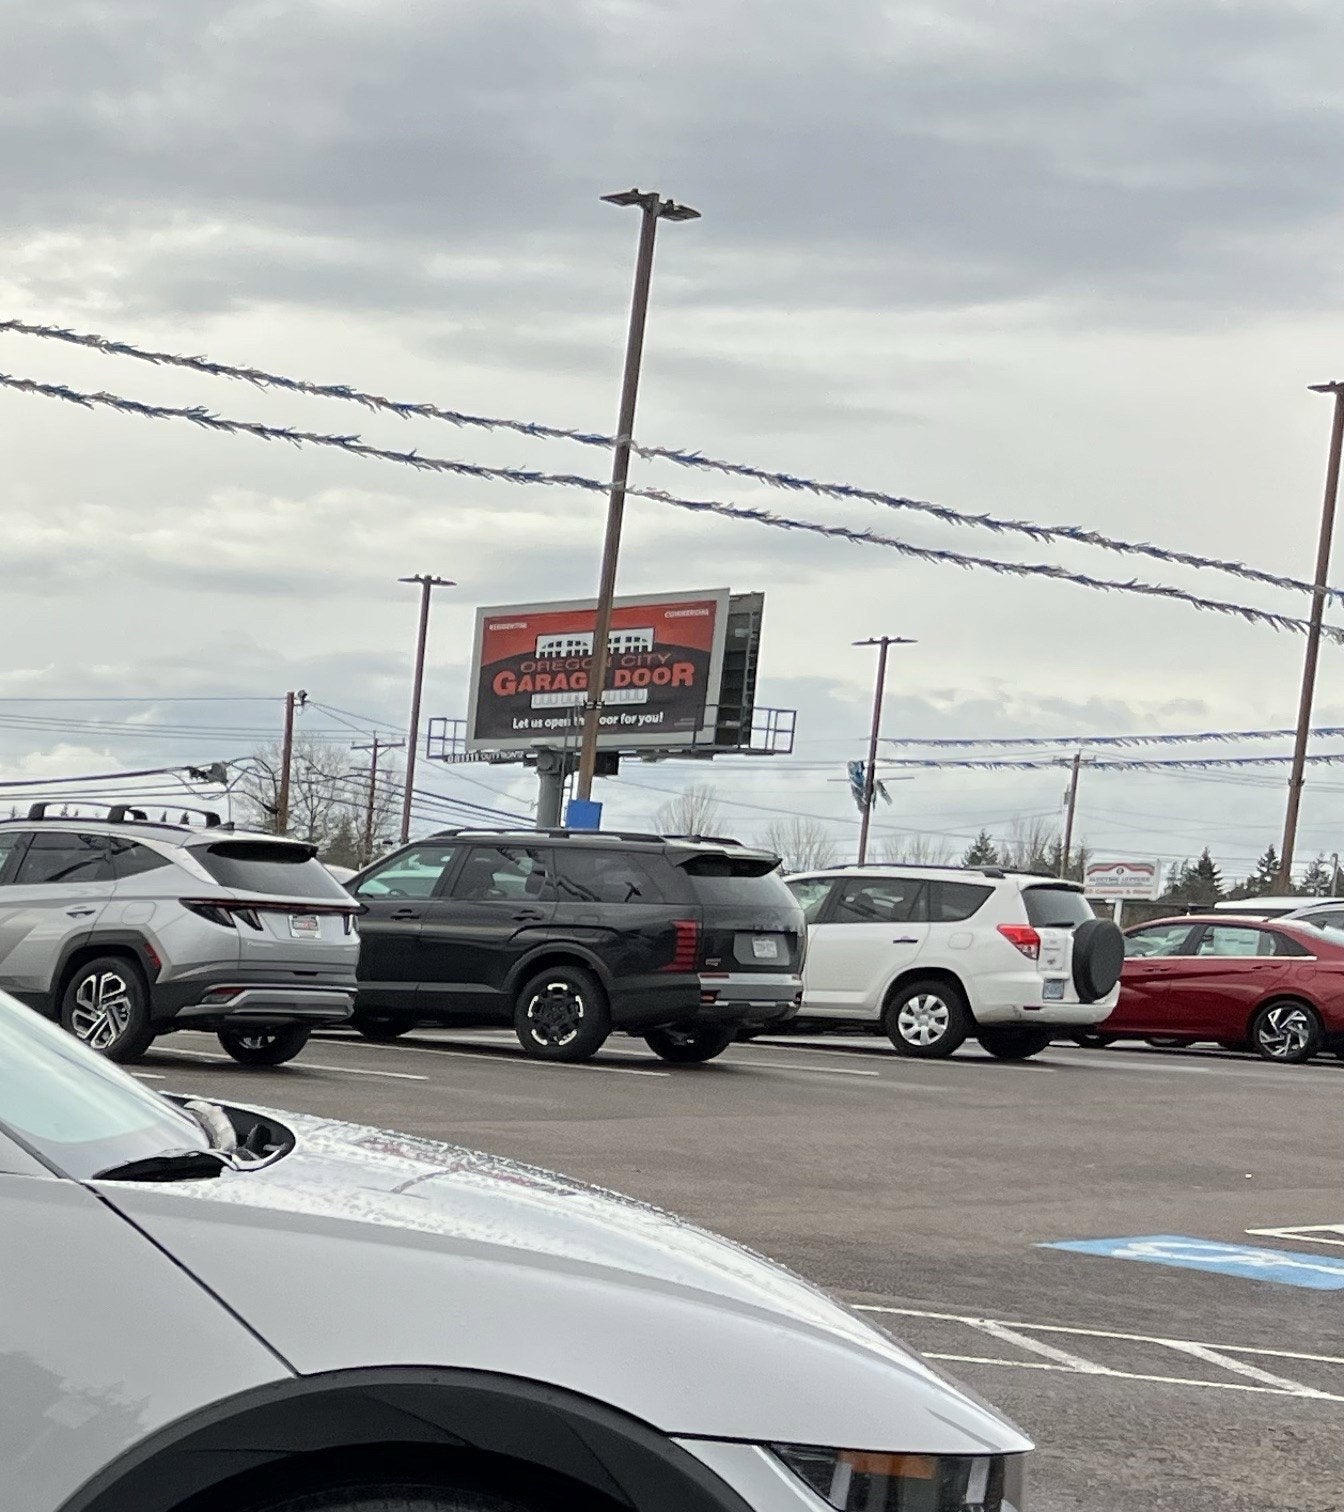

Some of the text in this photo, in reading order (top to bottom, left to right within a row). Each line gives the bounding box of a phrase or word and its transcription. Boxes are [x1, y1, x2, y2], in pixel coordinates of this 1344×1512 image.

[621, 653, 672, 667] CITY
[492, 661, 696, 697] GARAG DOOR
[512, 717, 530, 730] Let
[531, 718, 543, 729] us
[545, 717, 570, 730] open
[599, 715, 619, 726] oor
[620, 712, 637, 725] for
[638, 711, 665, 727] you!
